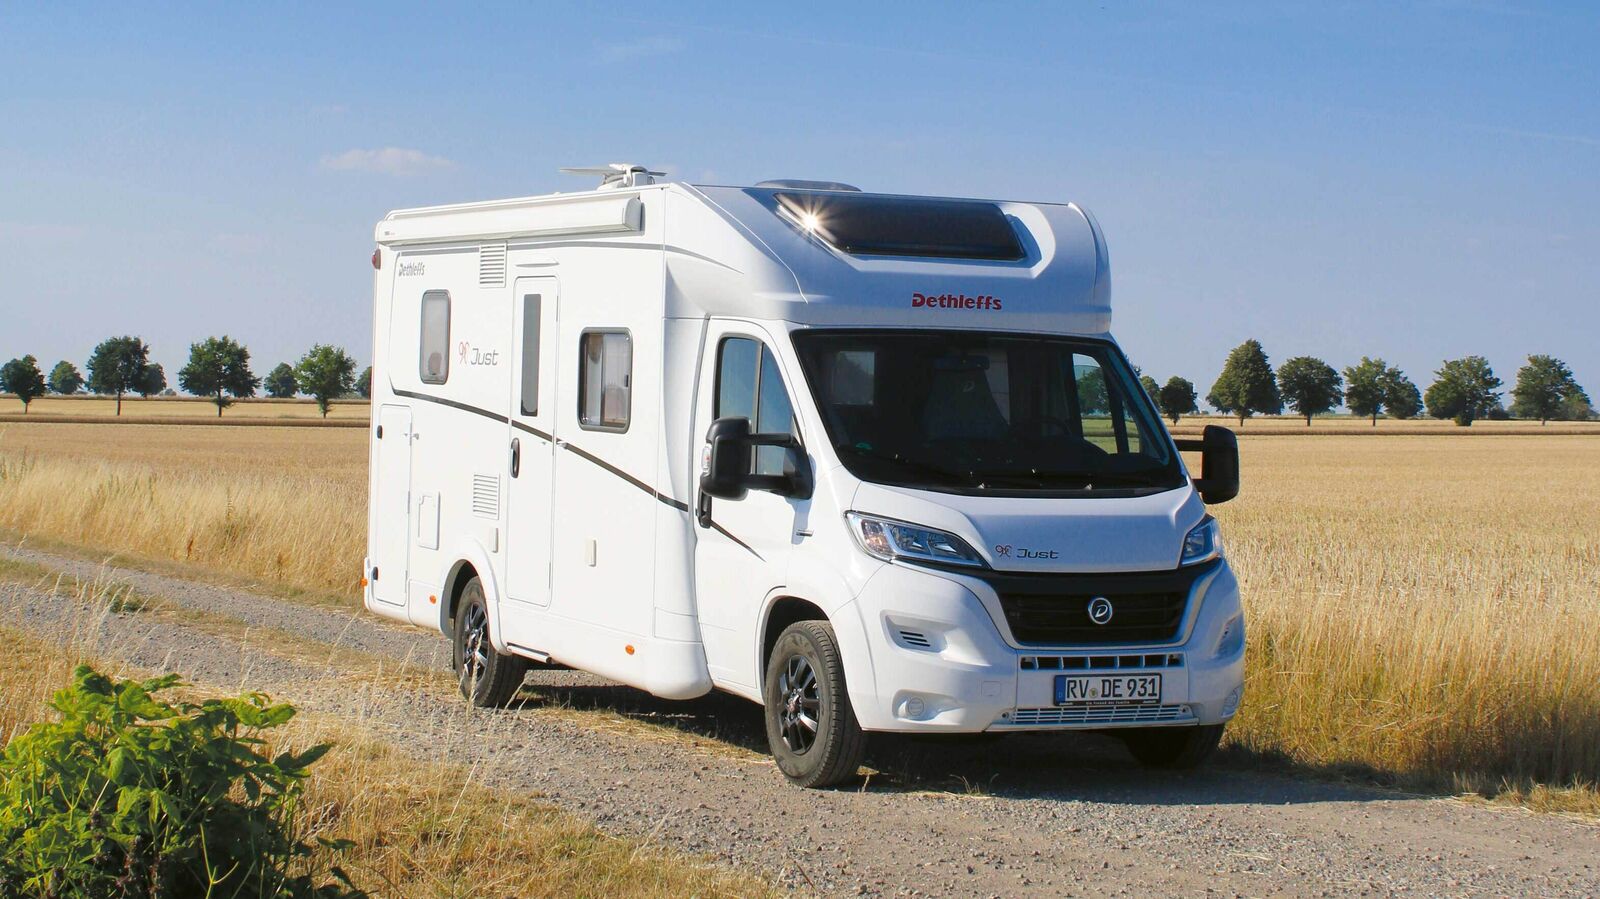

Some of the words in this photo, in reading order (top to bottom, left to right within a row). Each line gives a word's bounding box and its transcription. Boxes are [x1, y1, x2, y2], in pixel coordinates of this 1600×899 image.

[911, 292, 1002, 310] Dethleffs
[471, 347, 499, 366] Just
[1016, 548, 1059, 559] Just
[1066, 679, 1089, 698] RV
[1101, 679, 1122, 698] DE
[1127, 678, 1158, 697] 931
